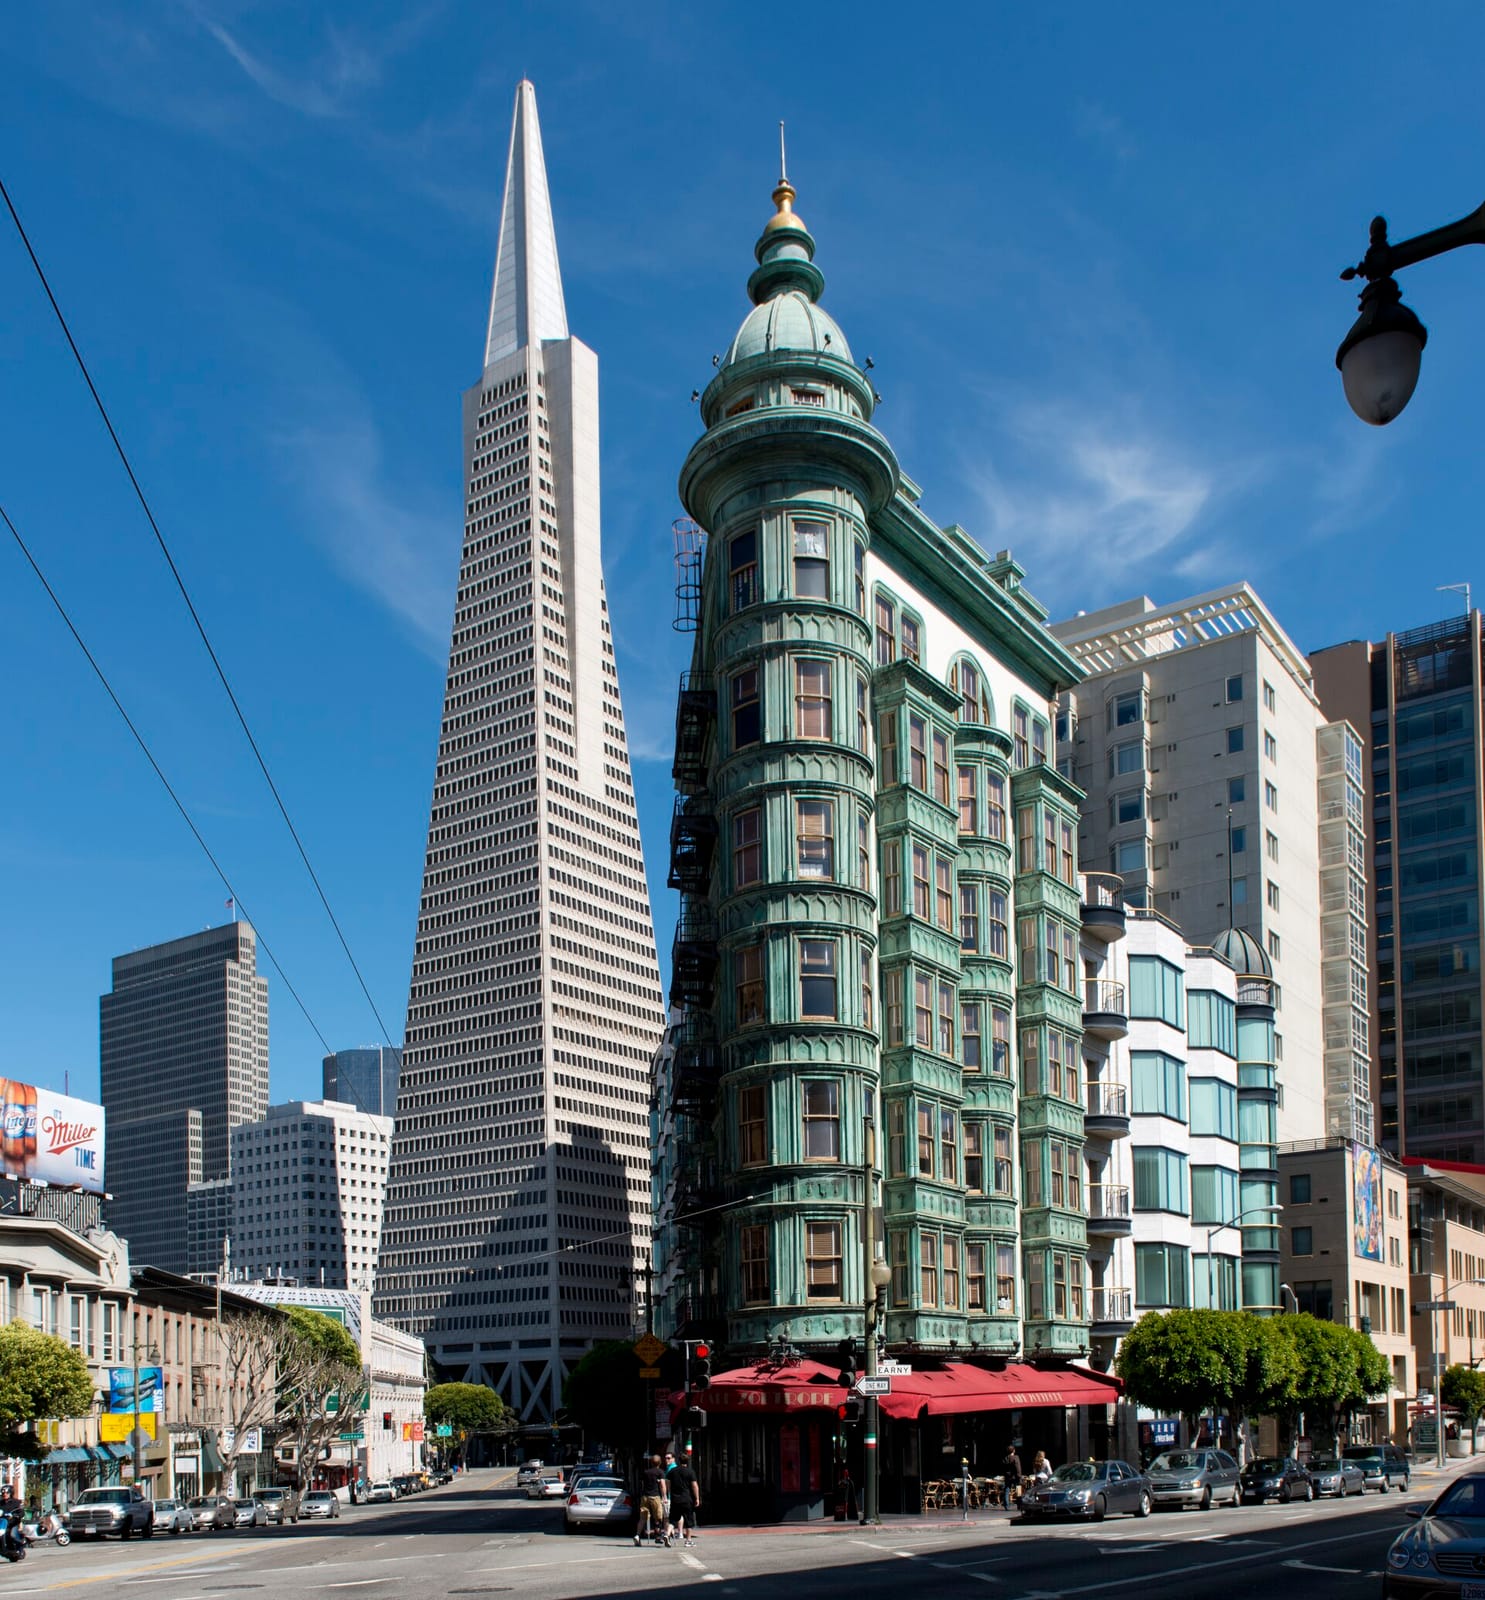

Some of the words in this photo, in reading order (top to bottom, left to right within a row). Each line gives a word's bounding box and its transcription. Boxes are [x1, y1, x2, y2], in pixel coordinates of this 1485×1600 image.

[42, 1116, 97, 1147] Miller
[75, 1147, 96, 1170] TIME
[878, 1366, 909, 1374] EARNY
[153, 1389, 163, 1412] RAYS
